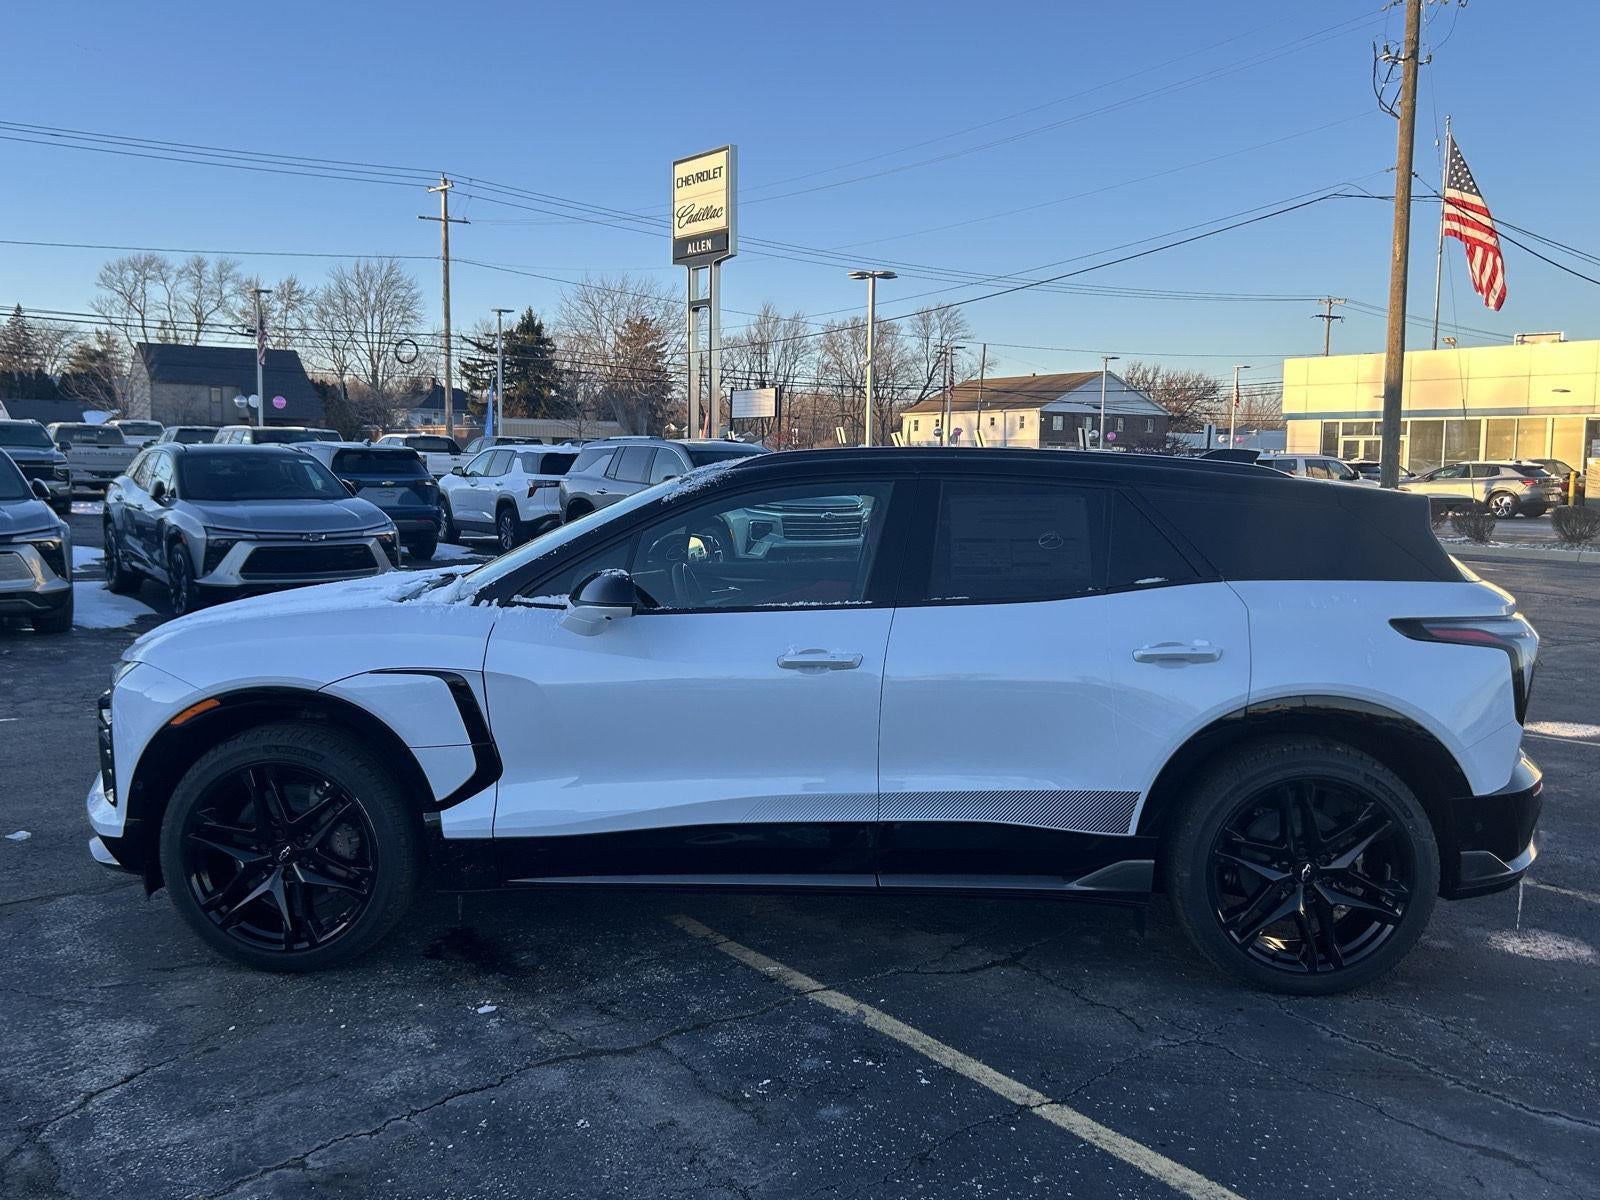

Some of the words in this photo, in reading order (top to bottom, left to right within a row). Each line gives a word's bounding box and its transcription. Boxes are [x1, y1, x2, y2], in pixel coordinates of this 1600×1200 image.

[676, 166, 723, 189] CHEVROLET
[676, 203, 723, 229] Cadillac
[687, 239, 711, 254] ALLEN
